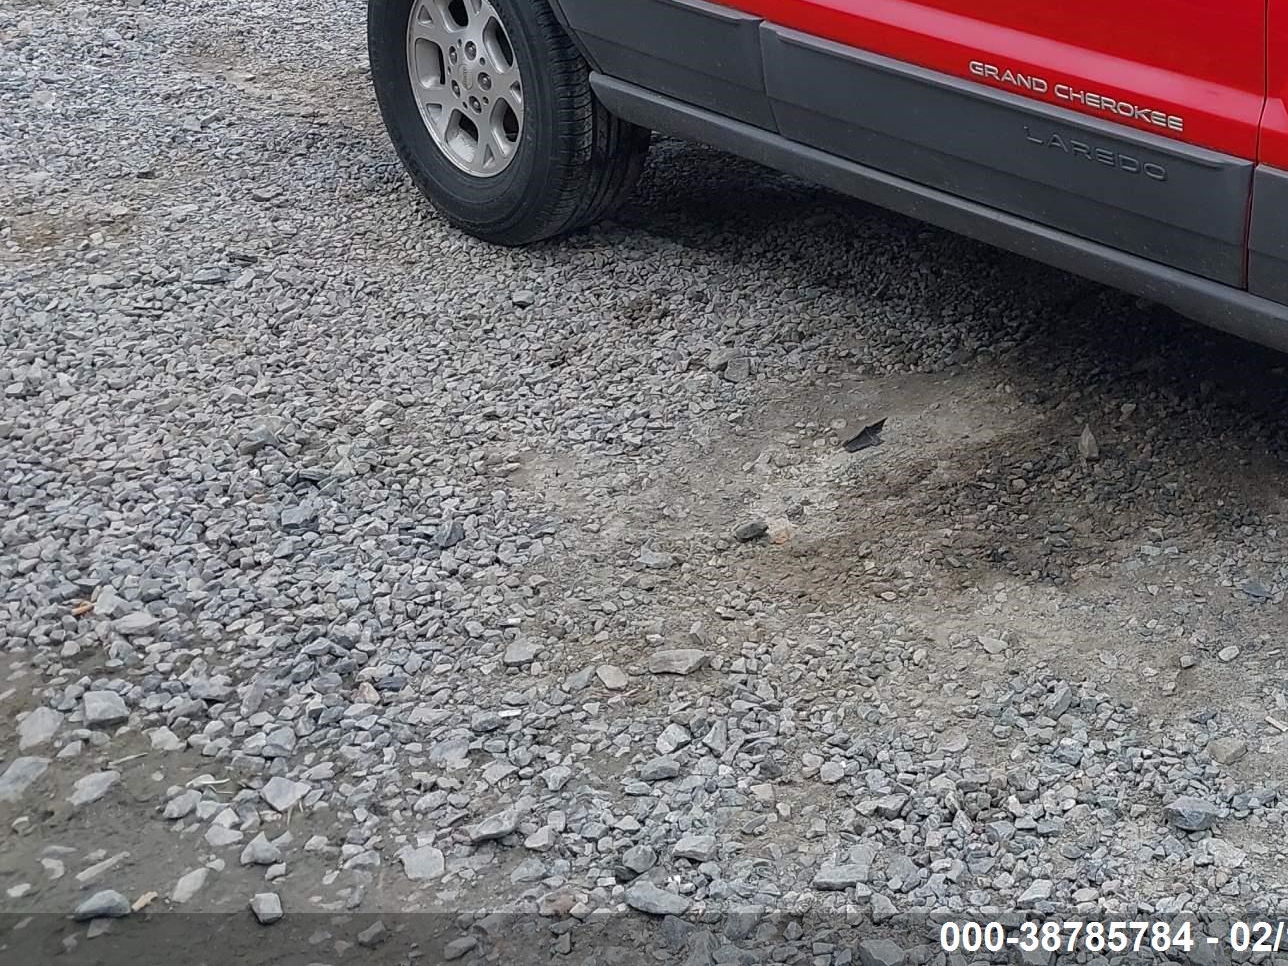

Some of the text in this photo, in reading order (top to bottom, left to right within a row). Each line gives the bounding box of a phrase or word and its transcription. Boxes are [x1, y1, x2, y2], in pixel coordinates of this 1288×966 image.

[968, 60, 1185, 133] GRAND CHEROKEE
[1023, 124, 1168, 182] LAREDO
